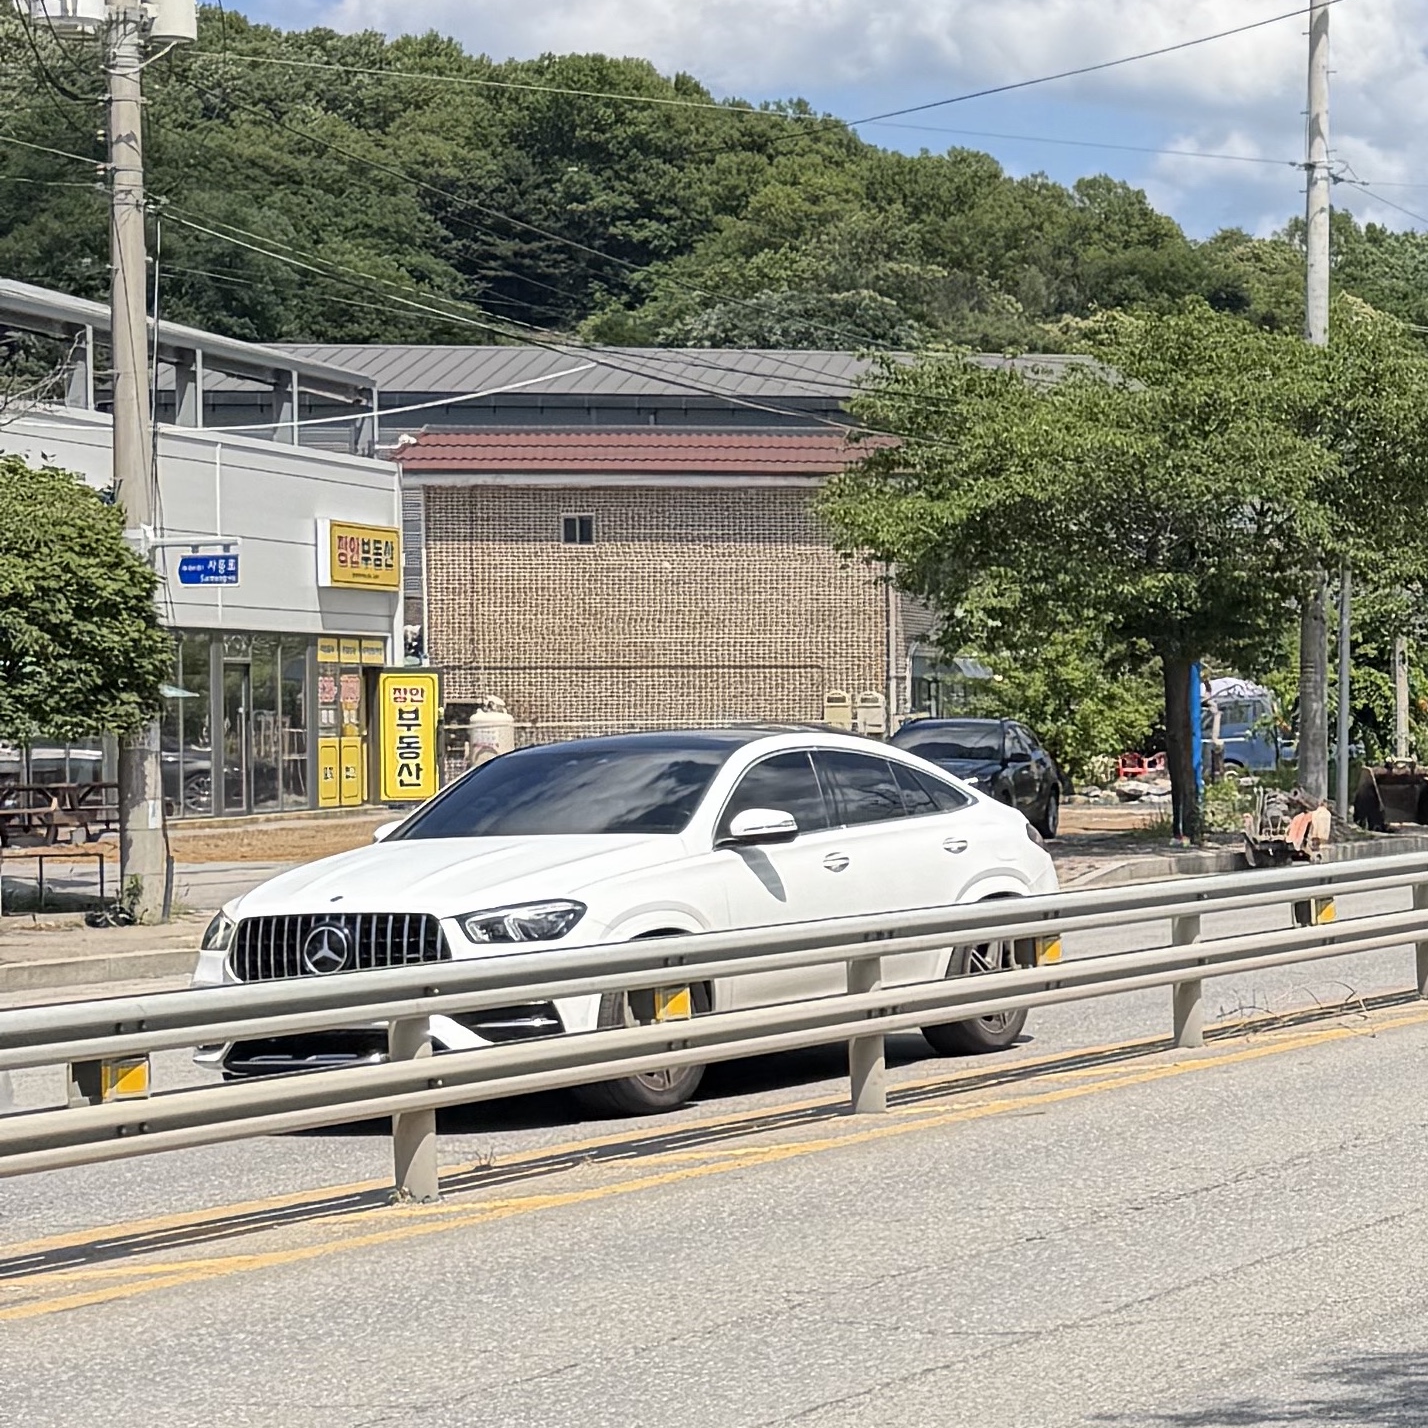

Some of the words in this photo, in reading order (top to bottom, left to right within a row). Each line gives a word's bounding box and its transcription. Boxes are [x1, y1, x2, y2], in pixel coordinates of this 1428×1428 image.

[337, 535, 394, 570] 장안부동산
[392, 687, 425, 703] 장안
[396, 706, 425, 788] 부동산
